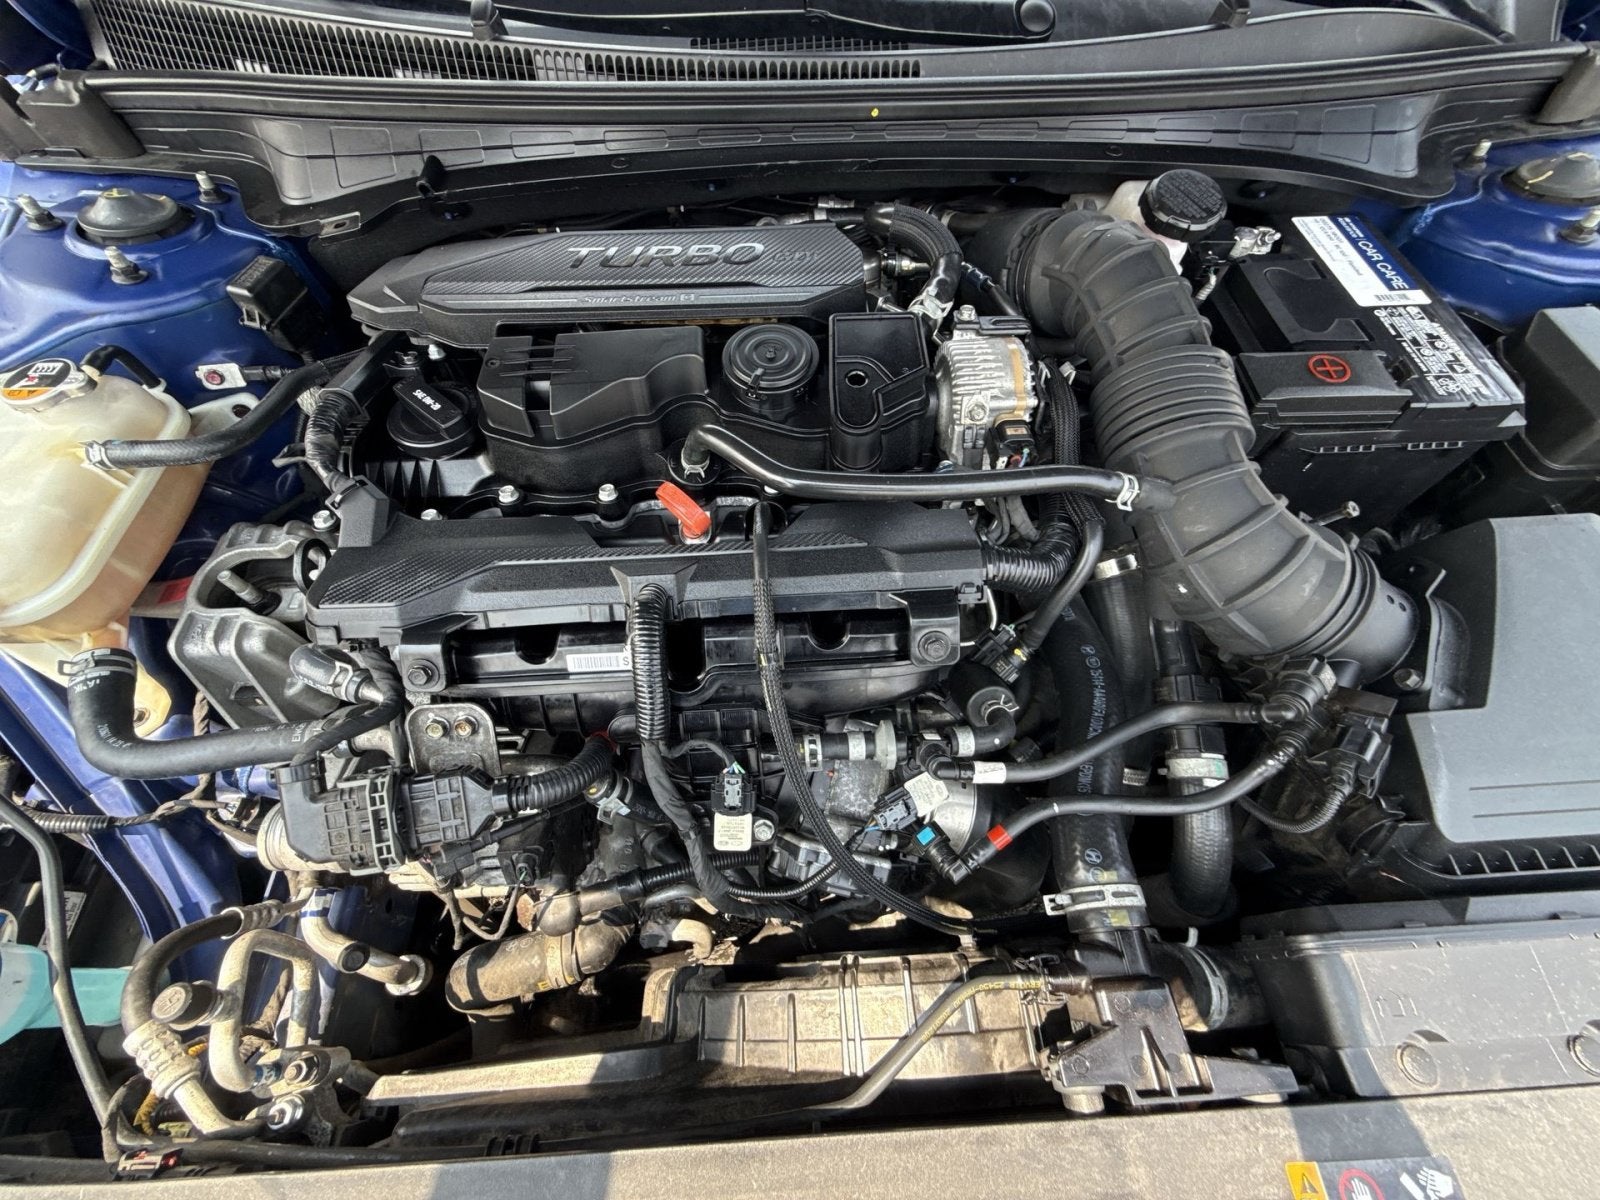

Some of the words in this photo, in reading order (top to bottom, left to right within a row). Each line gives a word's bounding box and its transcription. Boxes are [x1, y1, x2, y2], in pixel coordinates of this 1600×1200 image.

[567, 242, 765, 269] TURBO
[1358, 240, 1384, 262] CAR
[1376, 262, 1410, 290] CARE
[622, 656, 630, 666] S
